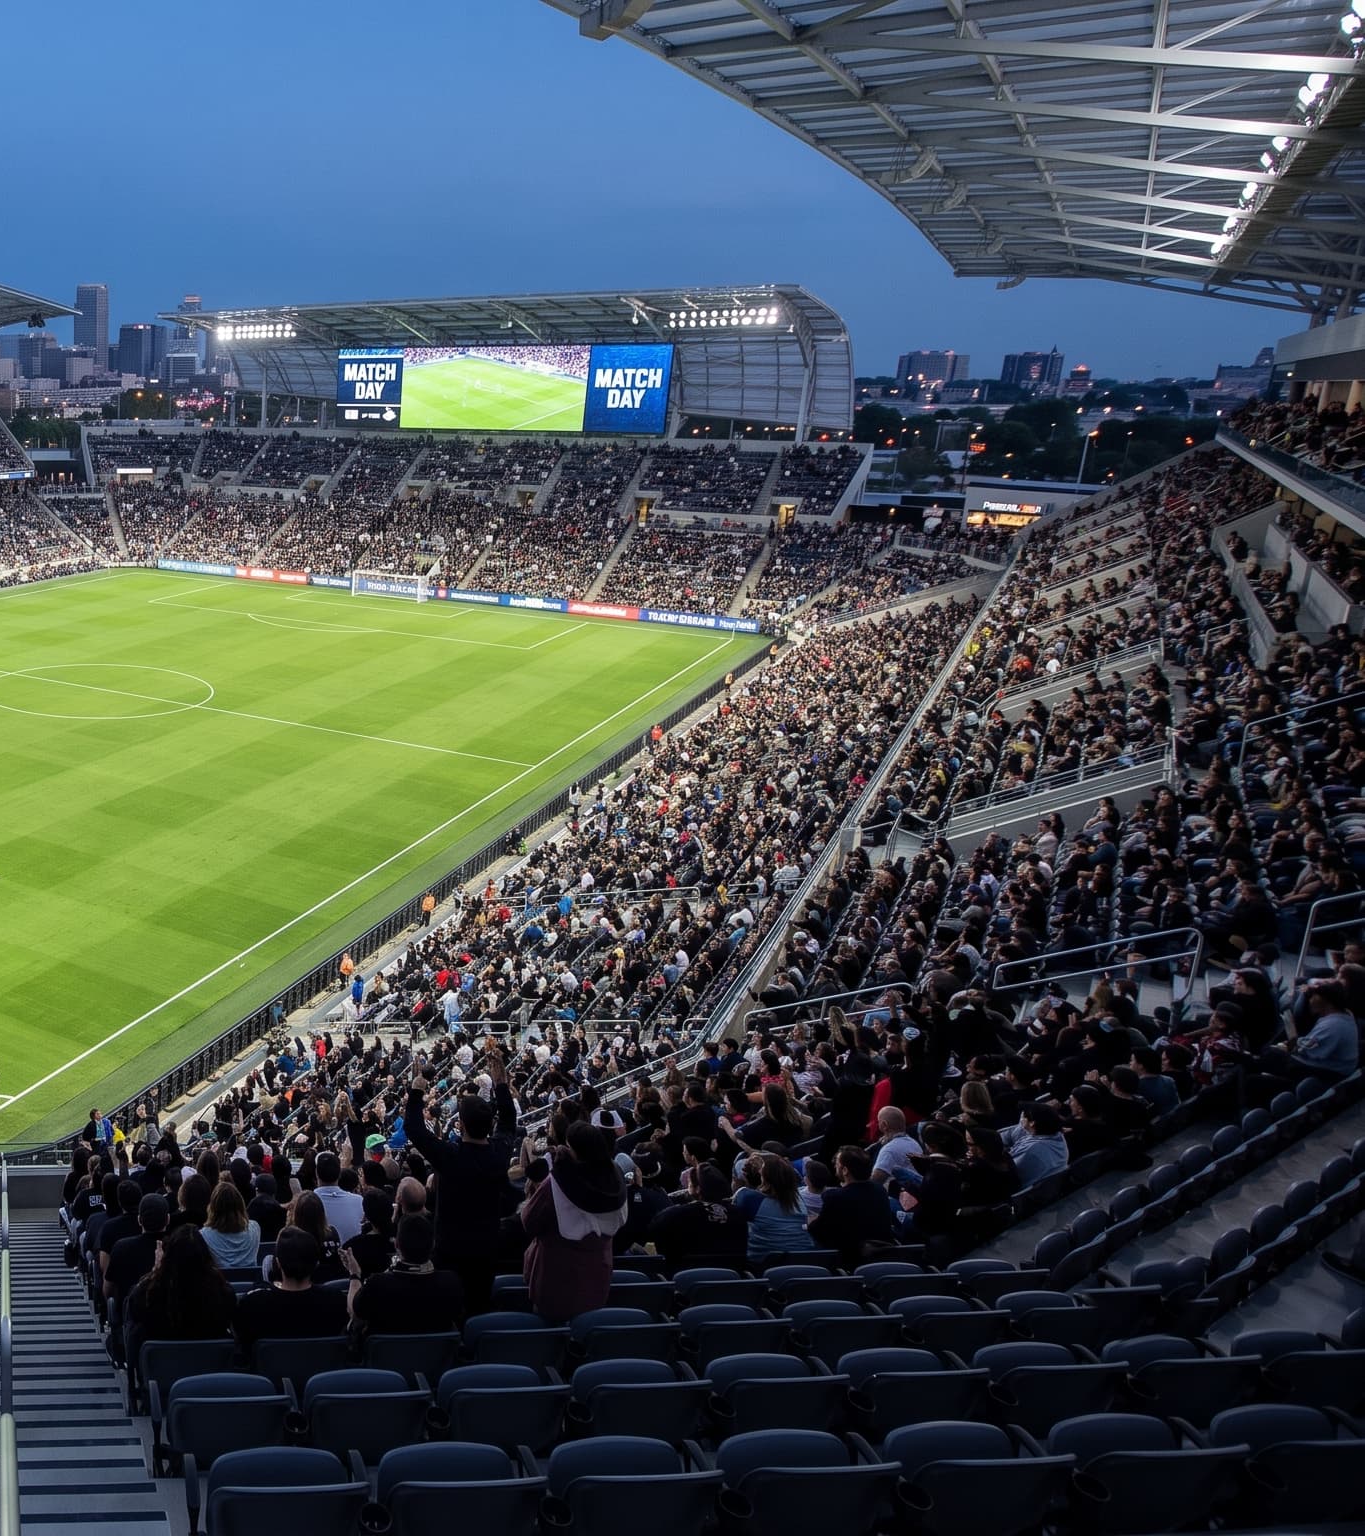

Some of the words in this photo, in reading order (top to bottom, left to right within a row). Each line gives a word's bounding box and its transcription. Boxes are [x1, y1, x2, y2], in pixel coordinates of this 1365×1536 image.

[344, 363, 397, 381] MATCH
[594, 368, 663, 388] MATCH
[355, 382, 385, 400] DAY
[606, 389, 646, 409] DAY
